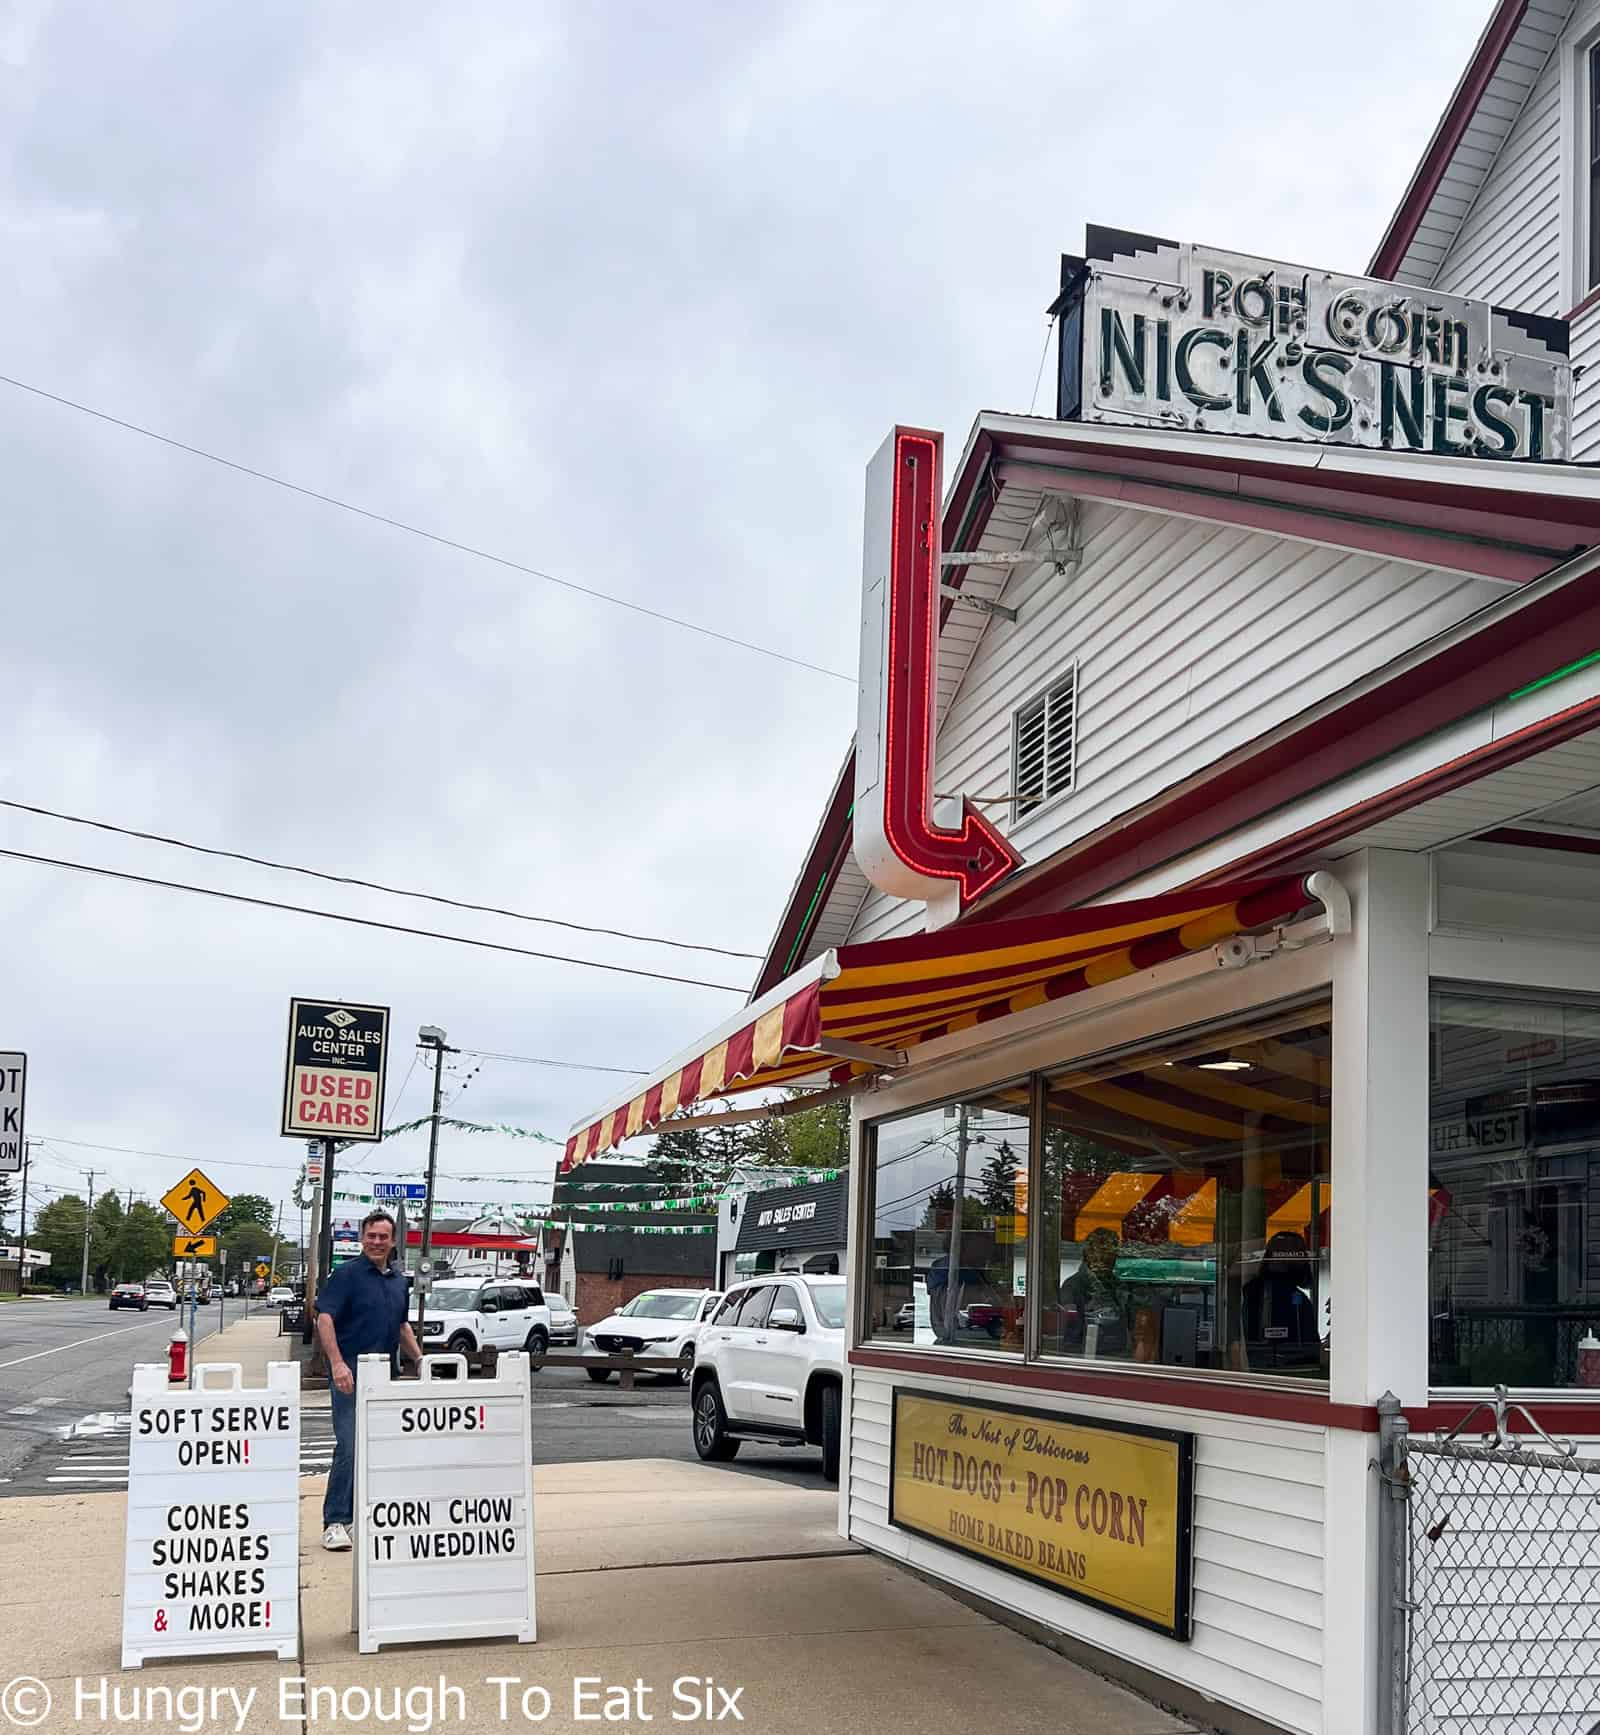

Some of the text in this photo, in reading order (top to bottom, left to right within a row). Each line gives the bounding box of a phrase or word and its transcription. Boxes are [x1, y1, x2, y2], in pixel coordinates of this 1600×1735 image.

[1202, 269, 1310, 336] POP
[1101, 308, 1554, 458] NICK'S NEST
[298, 1025, 381, 1044] AUTO SALES
[312, 1041, 365, 1056] CENTER
[301, 1073, 372, 1099] USED
[299, 1100, 370, 1127] CARS
[375, 1185, 407, 1197] DILLON
[773, 1207, 793, 1224] SALES
[792, 1202, 816, 1220] CENTER
[139, 1407, 291, 1434] SOFT SERVE
[401, 1406, 486, 1432] SOUPS!
[178, 1440, 250, 1466] OPEN!
[948, 1413, 1090, 1465] The Nest of Delicious
[912, 1441, 1148, 1548] HOT DOGS POP CORN
[167, 1504, 249, 1531] CONES
[373, 1498, 513, 1528] CORN CHOW
[152, 1534, 270, 1566] SUNDAES
[374, 1528, 516, 1560] IT WEDDING
[949, 1509, 1087, 1581] HOME BAKED BEANS
[164, 1568, 265, 1599] SHAKES
[153, 1600, 271, 1633] & MORE!
